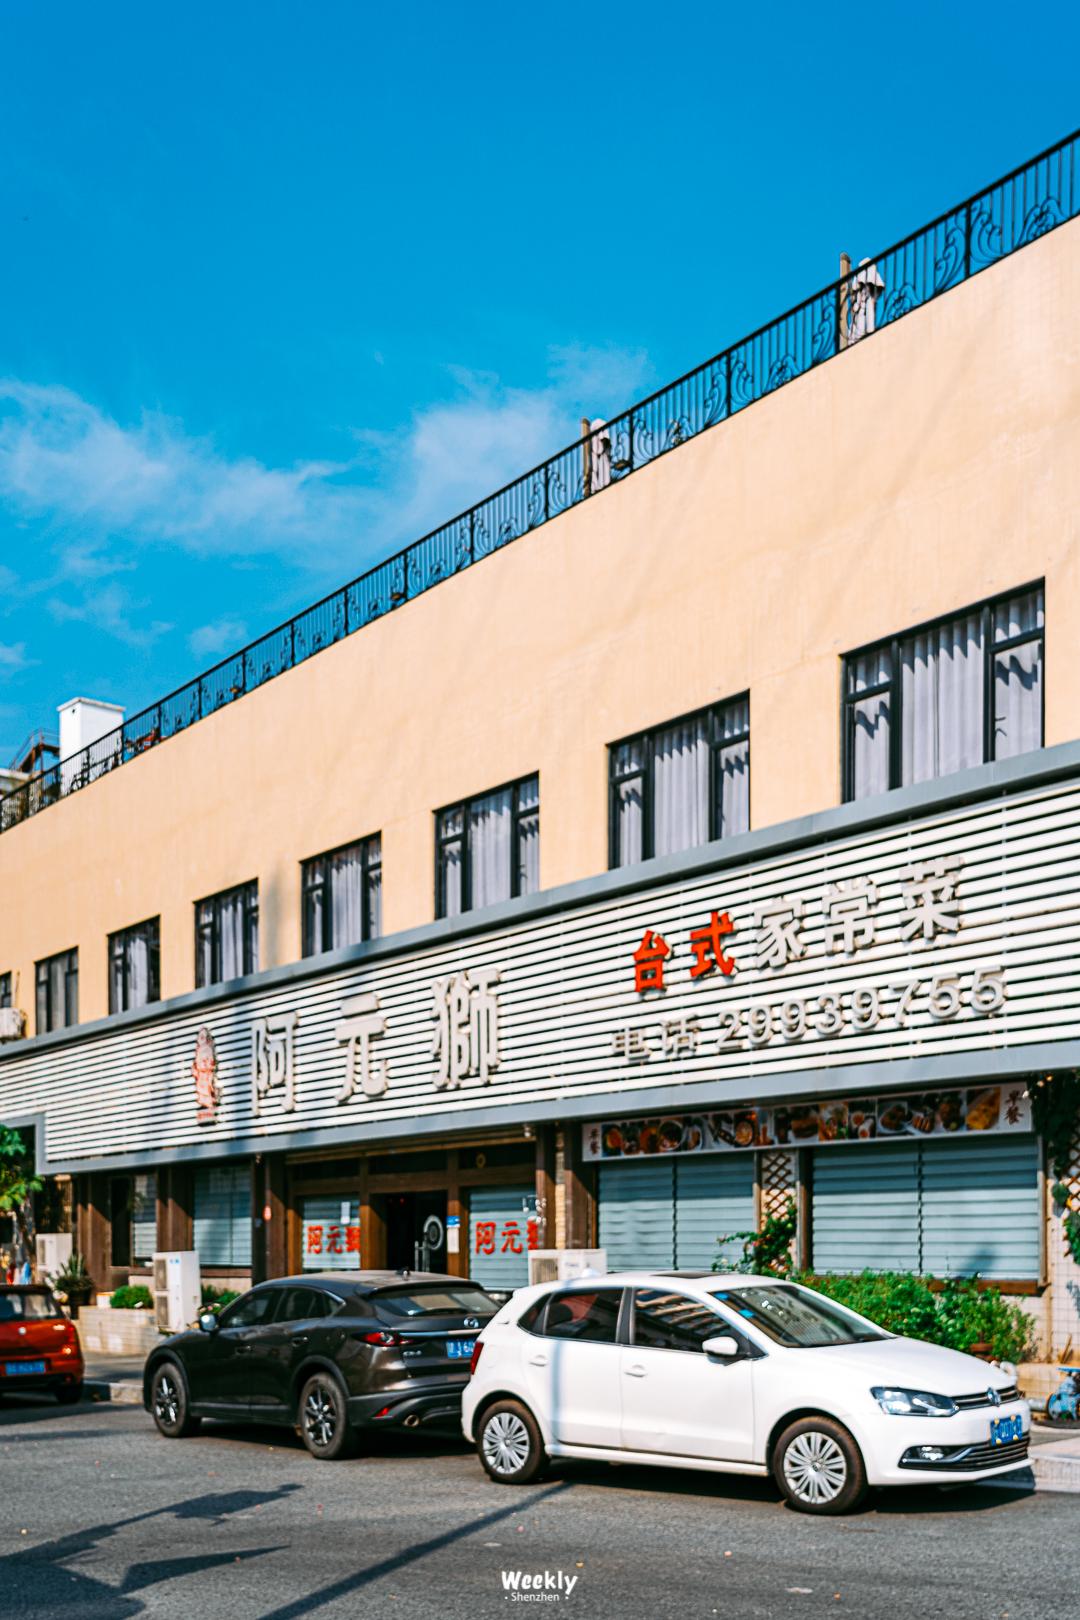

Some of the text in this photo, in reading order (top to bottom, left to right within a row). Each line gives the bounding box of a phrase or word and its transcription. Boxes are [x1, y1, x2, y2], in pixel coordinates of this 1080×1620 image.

[633, 853, 965, 994] 台式家常菜
[611, 964, 1010, 1061] 电话 29939755
